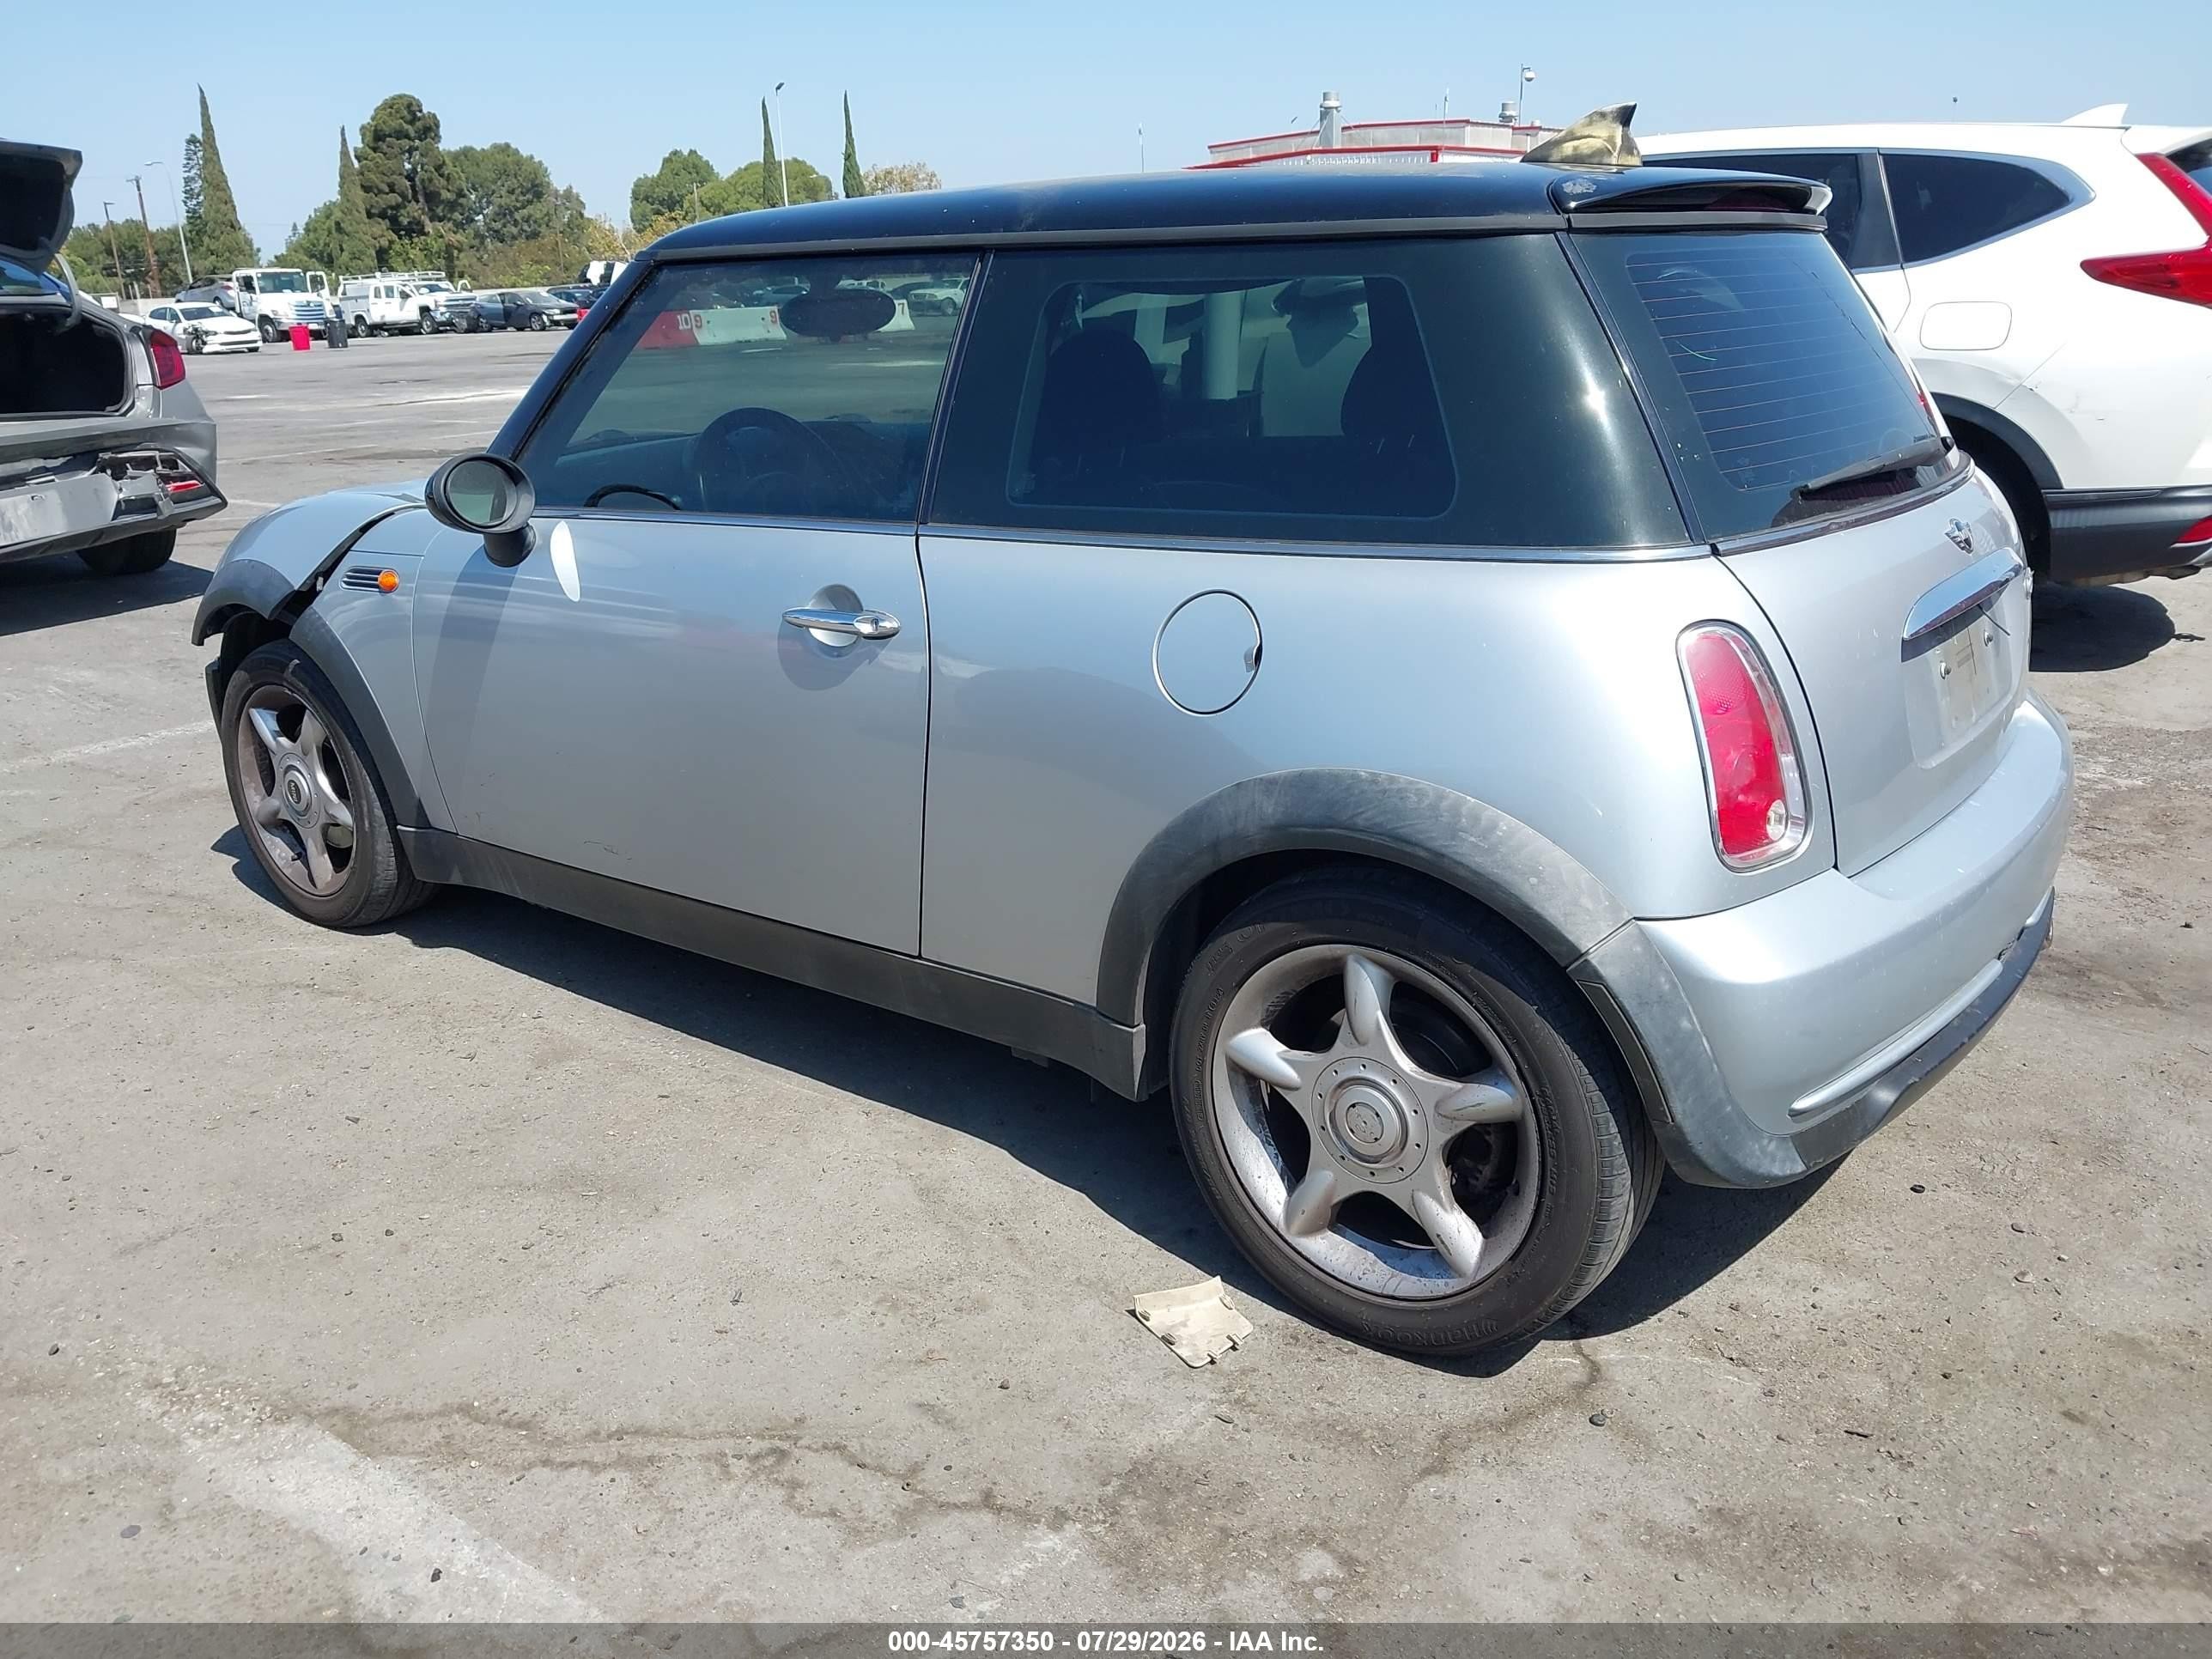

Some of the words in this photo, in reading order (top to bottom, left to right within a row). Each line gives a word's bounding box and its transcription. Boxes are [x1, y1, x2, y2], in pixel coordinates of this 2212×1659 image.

[897, 302, 905, 316] 7
[677, 313, 691, 331] 10
[694, 314, 702, 329] 9
[769, 310, 778, 324] 9
